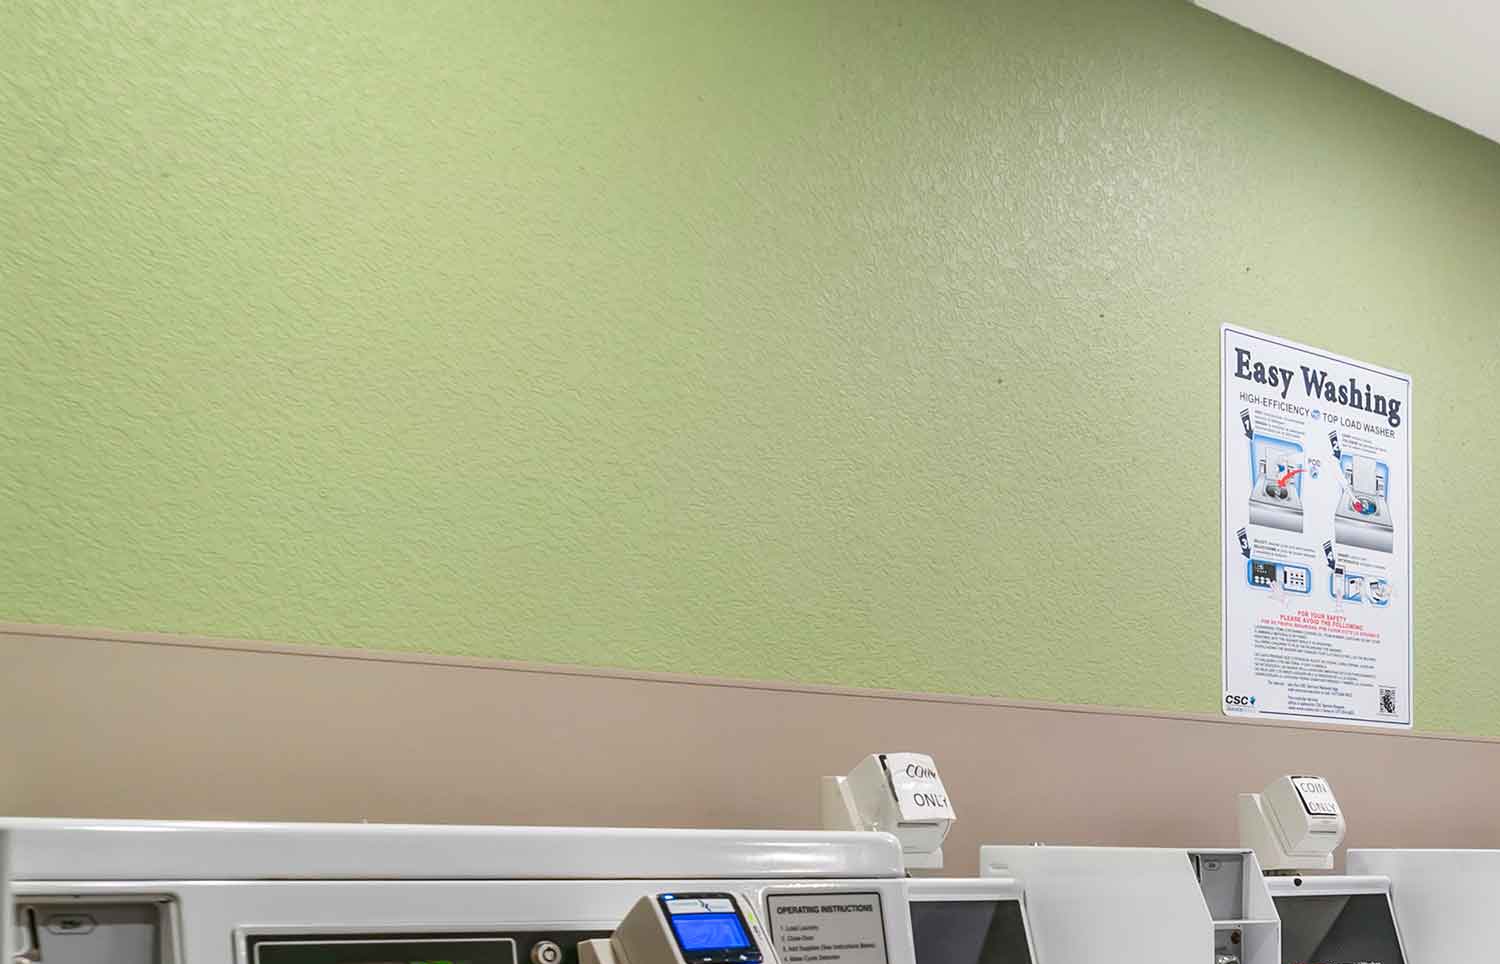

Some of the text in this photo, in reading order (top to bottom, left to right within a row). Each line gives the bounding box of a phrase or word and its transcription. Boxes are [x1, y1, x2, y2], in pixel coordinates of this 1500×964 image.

[1234, 347, 1401, 428] Easy Washing
[1239, 391, 1310, 417] HIGH-EFFICIENCY
[1323, 412, 1395, 439] TOP LOAD WASHER
[1225, 695, 1249, 705] CSC
[905, 763, 937, 779] COIN
[1300, 782, 1327, 793] COIN
[776, 904, 873, 914] OPERATING INSTRUCTIONS
